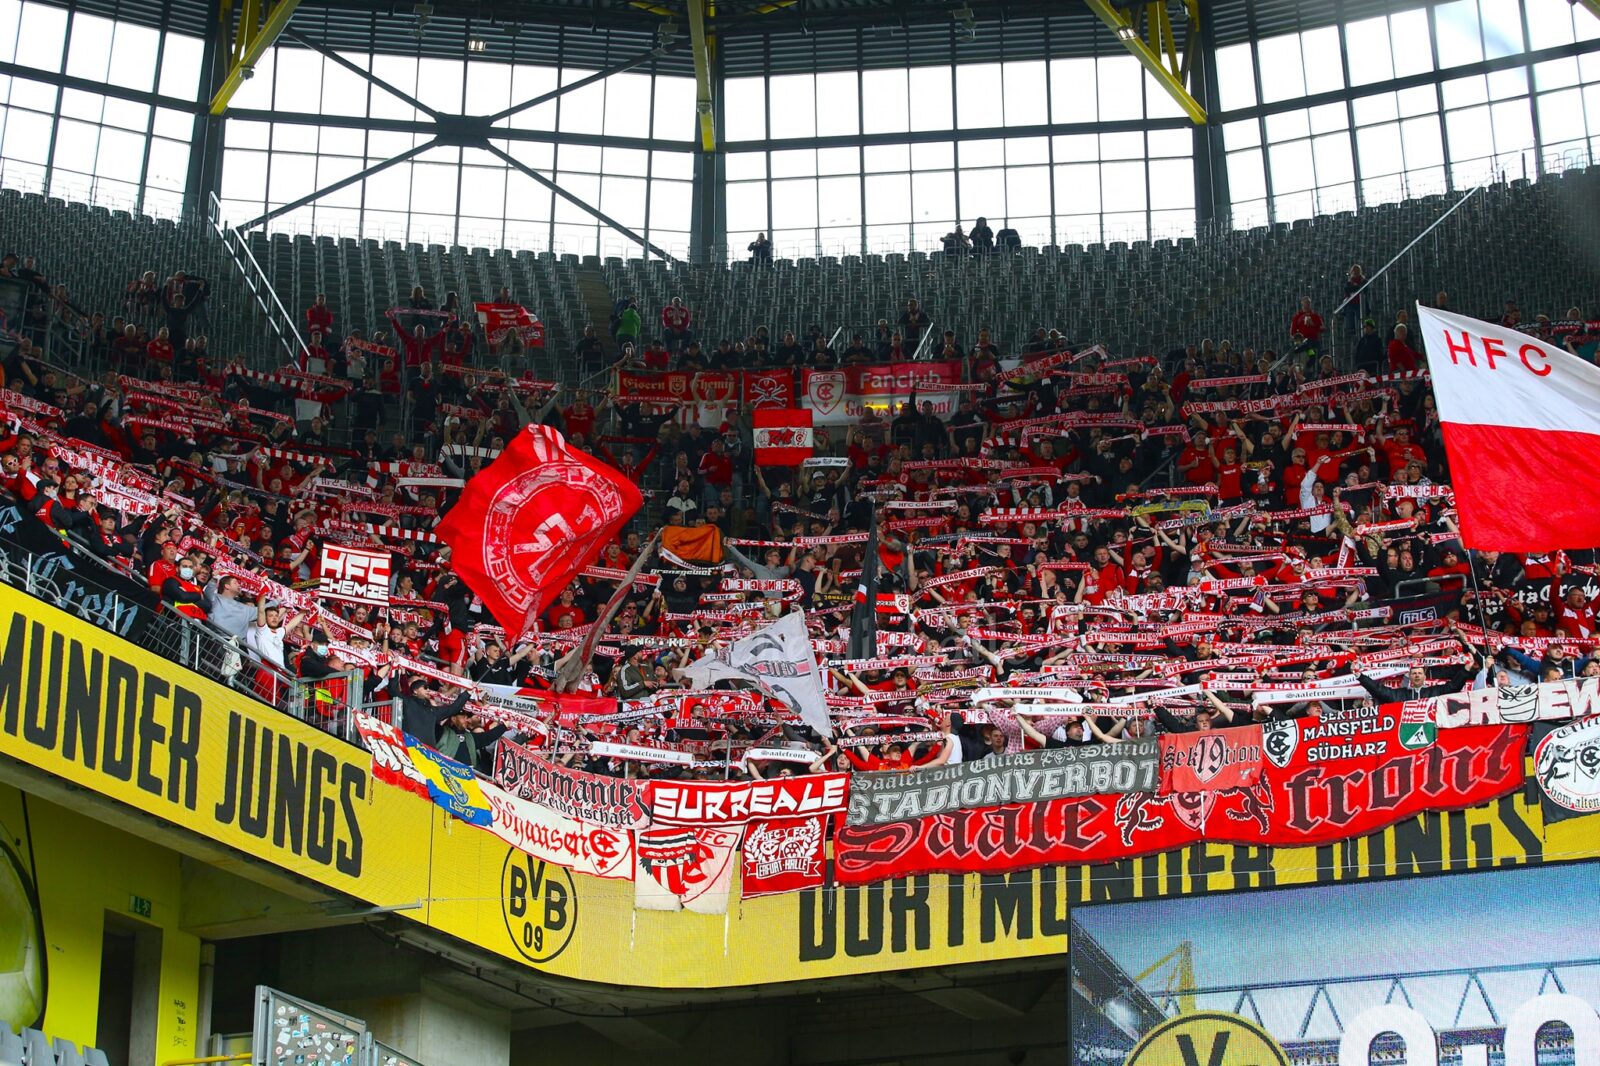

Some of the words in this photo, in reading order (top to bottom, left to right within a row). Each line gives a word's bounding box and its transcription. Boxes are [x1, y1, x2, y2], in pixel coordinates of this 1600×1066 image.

[1443, 329, 1552, 377] HFC
[321, 548, 389, 585] HFC
[320, 577, 389, 601] CHEMIE
[1210, 580, 1225, 590] HFC
[1227, 577, 1255, 589] CHEMIE
[854, 661, 889, 670] ERFURT
[908, 656, 936, 666] HALLE
[868, 689, 917, 701] KURT-WABBE
[1207, 681, 1253, 690] ERFURT
[1263, 718, 1289, 735] HFC
[1319, 705, 1380, 724] SEKTION
[1303, 717, 1395, 742] MANSFELD
[1307, 741, 1387, 763] SÜDHARZ
[846, 758, 1158, 823] STADIONVERBOT
[1286, 724, 1527, 835] front
[215, 711, 367, 878] JUNGS
[653, 778, 847, 820] SURREALE
[762, 828, 781, 841] HFC
[838, 797, 1107, 872] Saale
[759, 860, 783, 877] ERFURT
[785, 858, 808, 871] HALLE
[510, 853, 568, 931] BVB
[524, 921, 544, 952] 09
